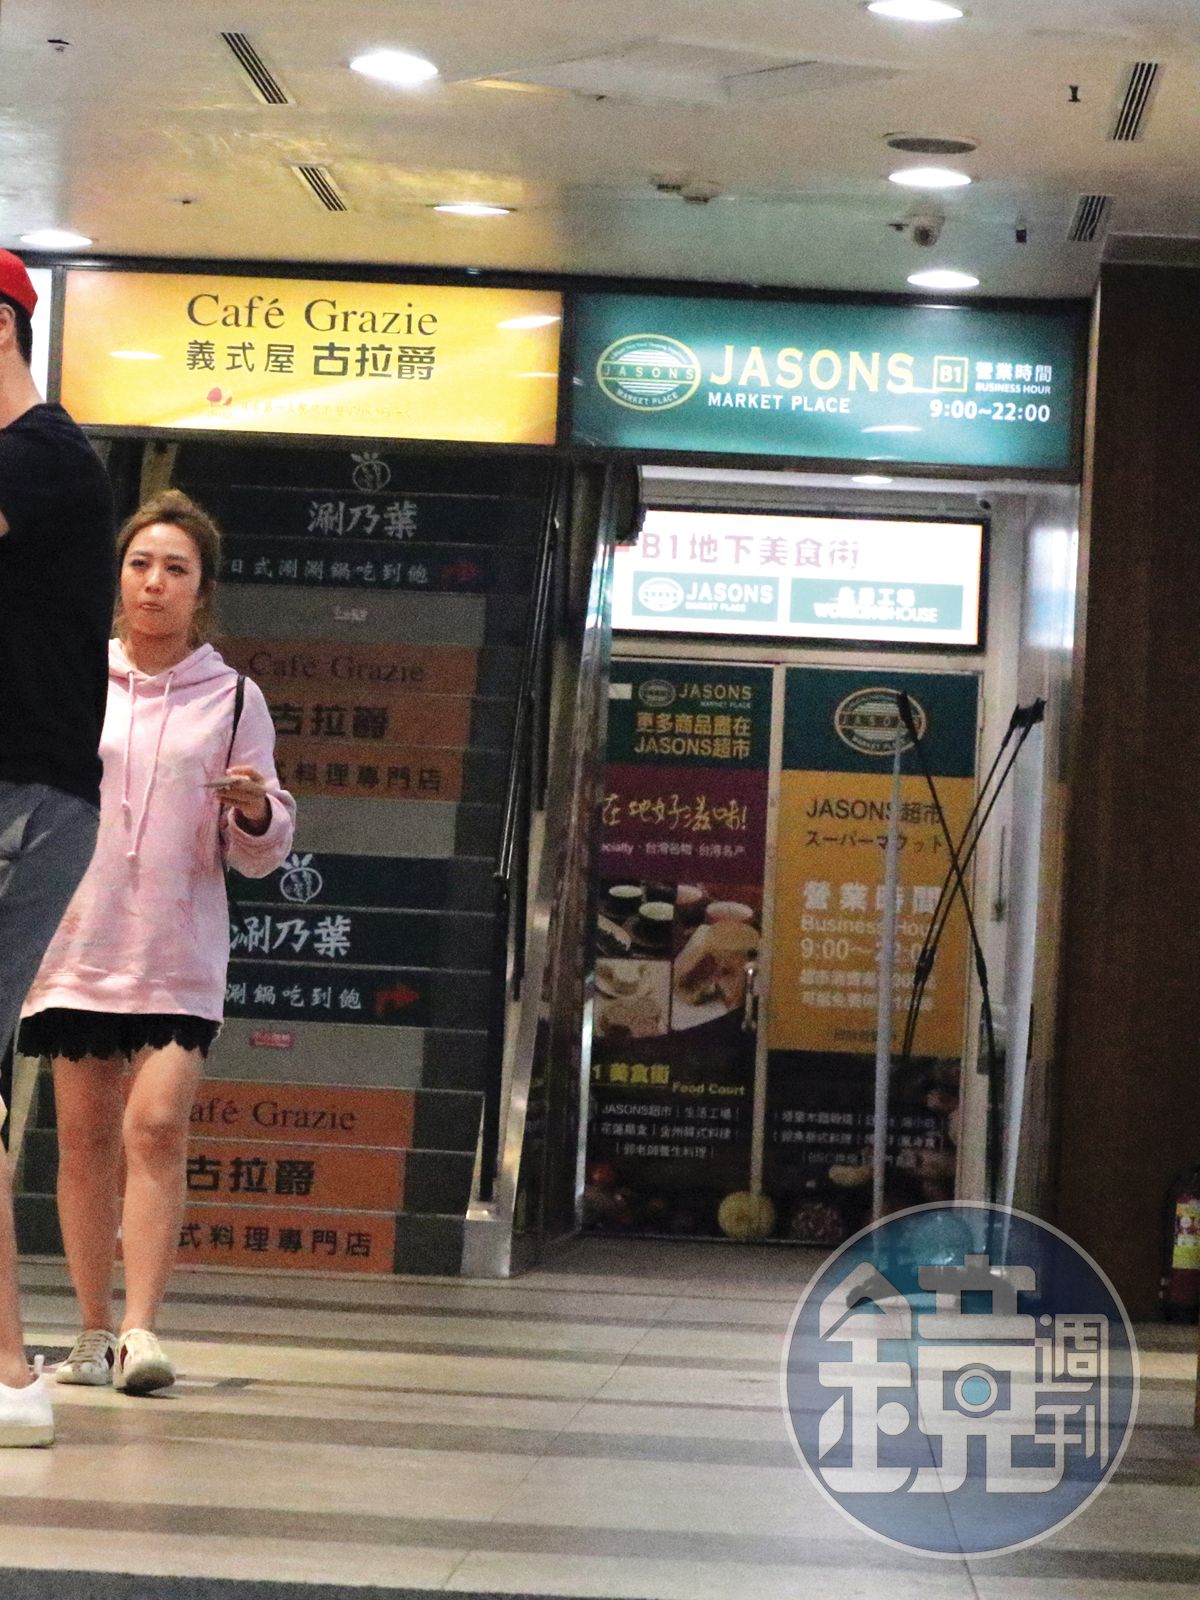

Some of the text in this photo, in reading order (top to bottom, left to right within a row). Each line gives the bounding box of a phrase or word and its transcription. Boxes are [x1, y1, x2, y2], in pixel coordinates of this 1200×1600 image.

[187, 293, 439, 337] Café Grazie
[186, 339, 436, 381] 義式屋 古拉爵
[604, 365, 694, 380] JASONS
[710, 344, 914, 392] JASONS
[940, 364, 964, 384] B1
[975, 361, 1053, 383] 營業時間
[975, 381, 1052, 395] BUSINESS HOUR
[708, 391, 851, 414] MARKET PLACE
[307, 500, 418, 539] 涮乃葉
[641, 532, 860, 570] B1地下美食街
[685, 582, 774, 604] JASONS
[249, 651, 425, 683] Café Grazie
[678, 683, 752, 700] JASONS
[634, 736, 751, 760] JASONS超市
[229, 914, 352, 958] 涮乃葉
[672, 1081, 746, 1097] Food Court
[253, 1100, 359, 1132] Grazie
[187, 1154, 316, 1197] 古拉爵
